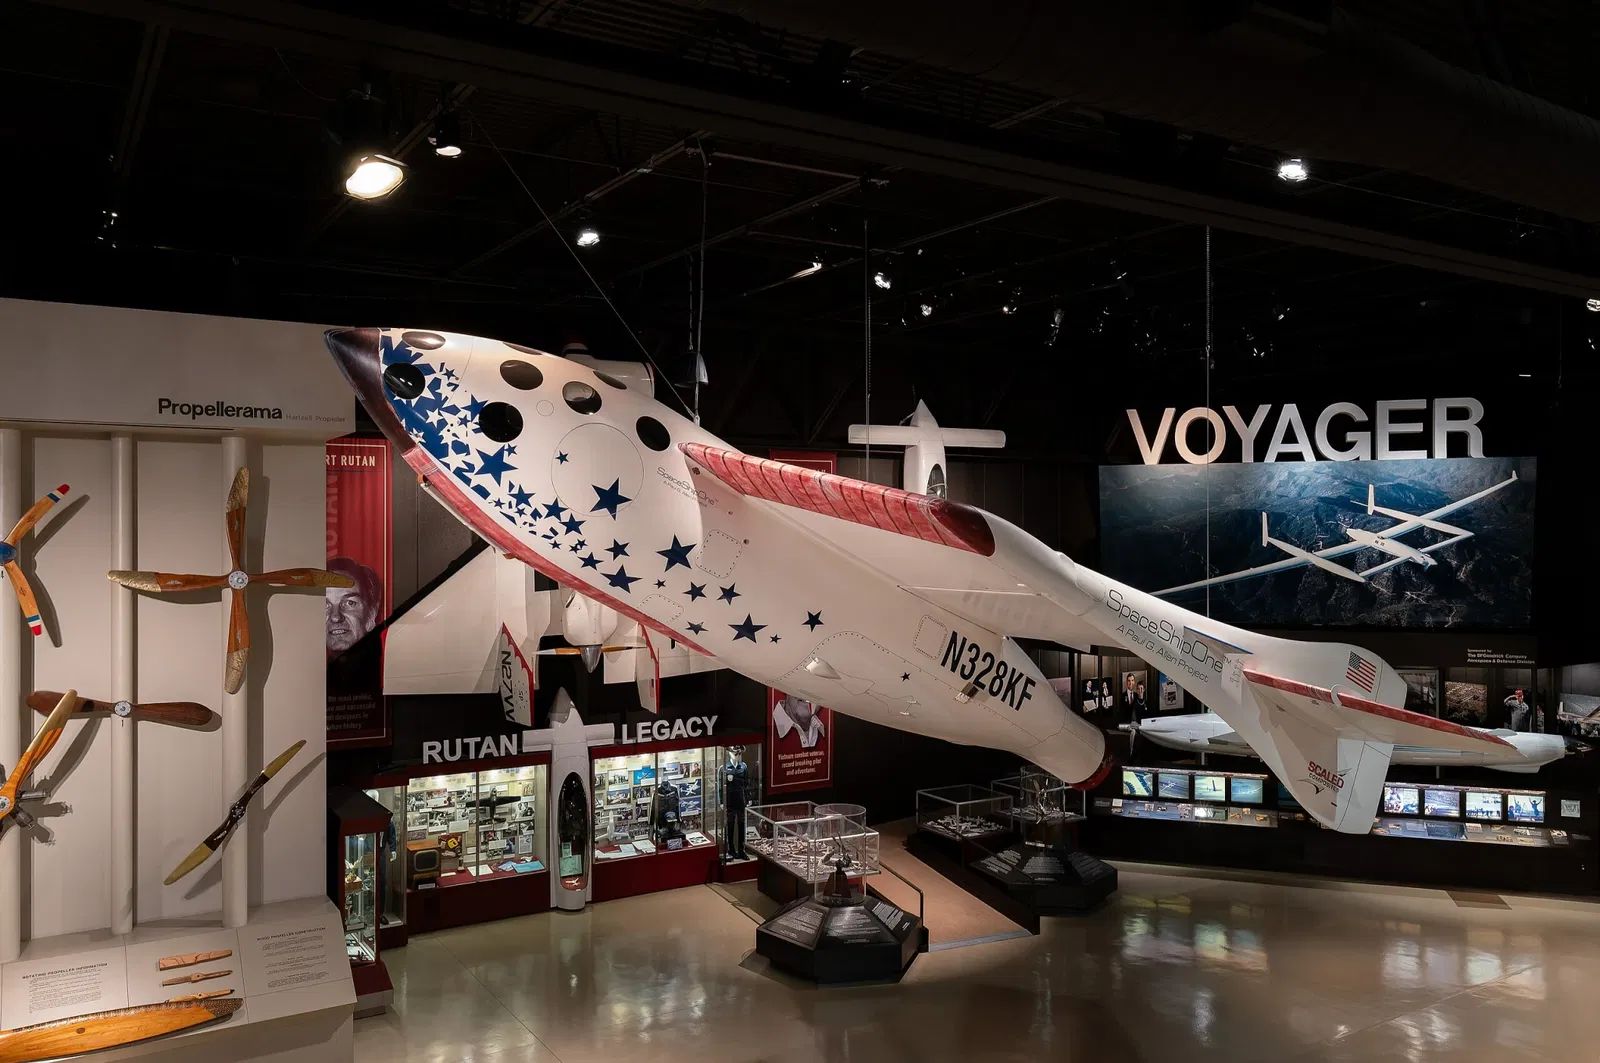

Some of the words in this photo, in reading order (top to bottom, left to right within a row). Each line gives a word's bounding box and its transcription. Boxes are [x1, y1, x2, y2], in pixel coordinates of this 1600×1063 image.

[157, 398, 282, 420] Propellerama
[286, 413, 313, 421] Hartzell
[315, 415, 346, 423] Propeller
[1126, 397, 1487, 465] VOYAGER
[326, 455, 336, 466] RT
[340, 455, 376, 467] RUTAN
[656, 466, 715, 506] SpaceShipOne
[1106, 589, 1224, 674] SpaceShipOne
[1116, 624, 1125, 635] A
[1124, 628, 1146, 645] Paul
[1156, 647, 1178, 667] Allen
[1177, 658, 1209, 684] Project
[940, 630, 1037, 712] N328KF
[621, 715, 719, 745] LEGACY
[422, 733, 519, 764] RUTAN
[794, 759, 813, 767] breaking
[812, 758, 822, 766] pilot
[1307, 761, 1345, 789] SCALED
[1308, 772, 1340, 794] COMPOSITES
[47, 967, 75, 976] PROPELLER
[76, 962, 108, 971] INFORMATION
